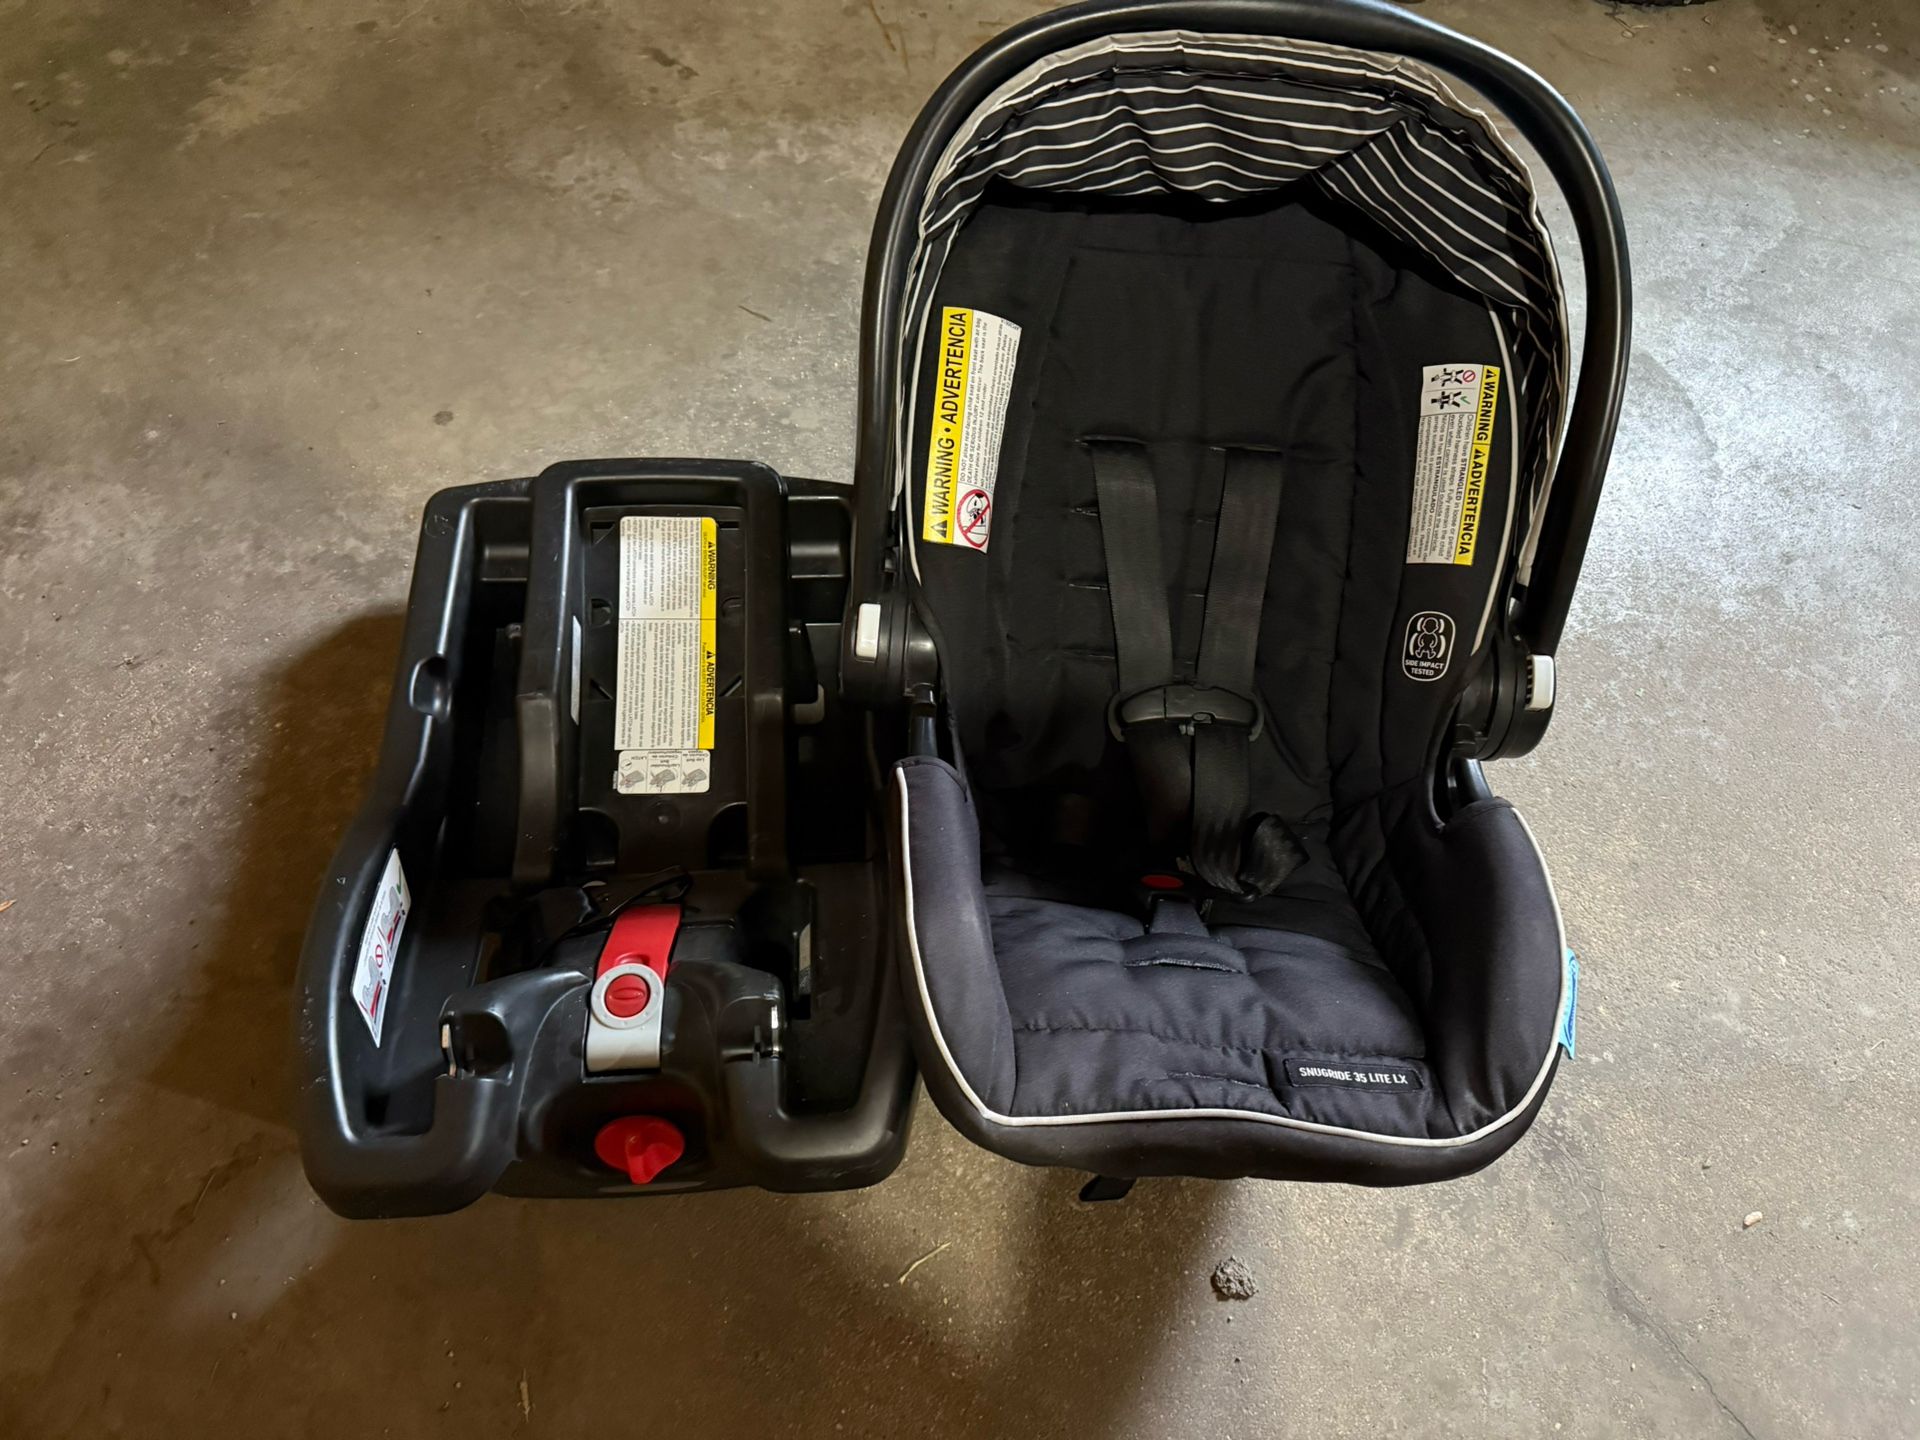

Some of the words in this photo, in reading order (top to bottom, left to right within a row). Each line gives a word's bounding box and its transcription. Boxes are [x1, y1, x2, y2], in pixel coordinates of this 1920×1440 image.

[940, 310, 966, 424] ADVERTENCIA
[1476, 381, 1495, 441] WARNING
[1455, 414, 1464, 438] buckled
[1464, 414, 1473, 439] Children
[1451, 440, 1460, 464] harness
[1461, 441, 1469, 456] have
[932, 436, 955, 516] WARNING
[1455, 458, 1466, 500] STRANGLED
[1445, 488, 1453, 503] Fully
[1458, 460, 1483, 555] ADVERTENCIA
[1444, 535, 1454, 560] partially
[707, 549, 715, 589] WARNING
[1411, 667, 1434, 675] TESTED
[1419, 660, 1444, 669] IMPACT
[705, 661, 714, 715] ADVERTENCIA
[1298, 1067, 1352, 1081] SNUGRIDE
[1353, 1072, 1367, 1083] 35
[1368, 1073, 1391, 1084] LITE
[1392, 1073, 1408, 1084] LX
